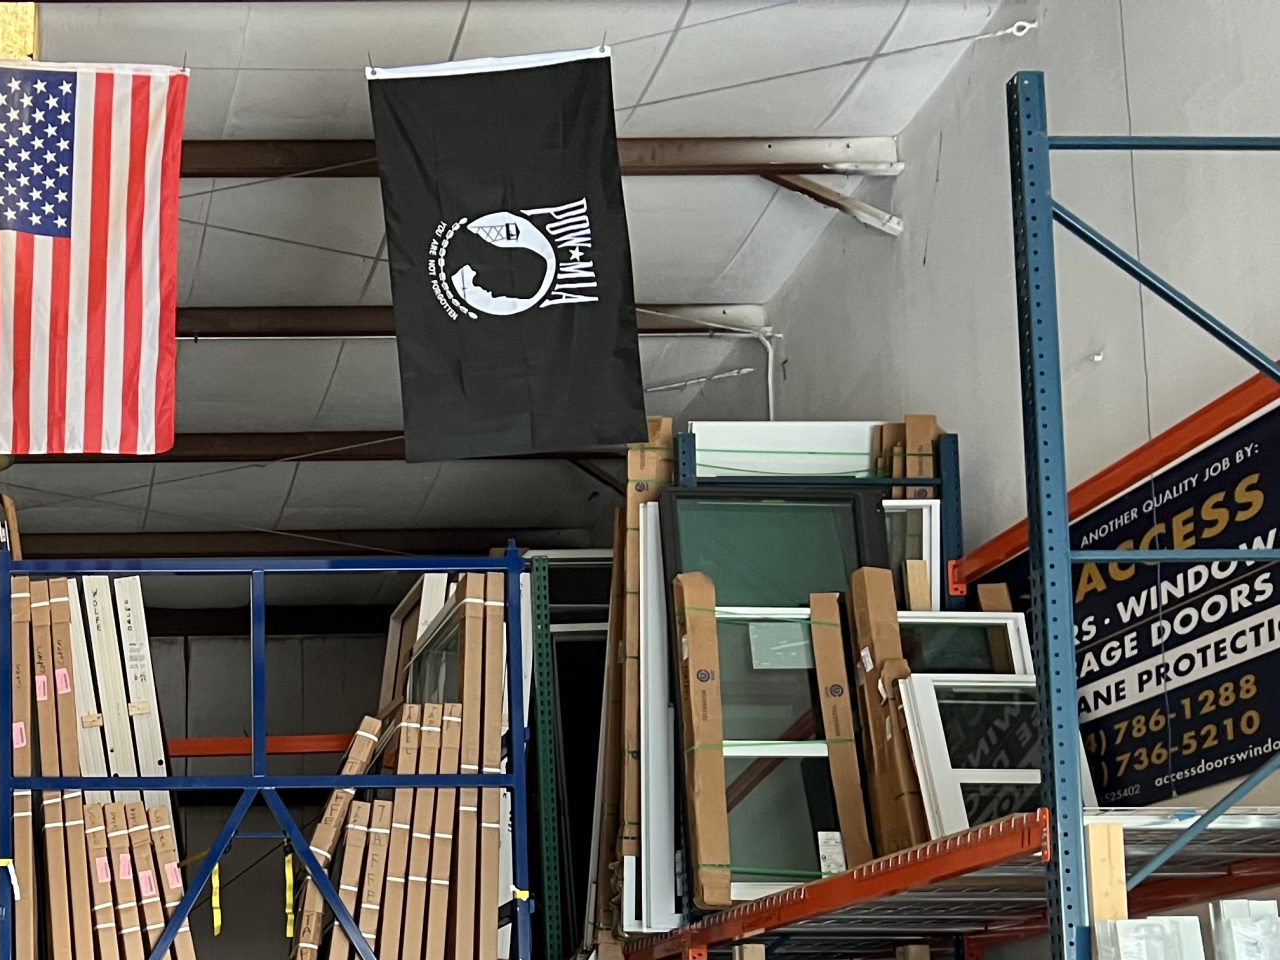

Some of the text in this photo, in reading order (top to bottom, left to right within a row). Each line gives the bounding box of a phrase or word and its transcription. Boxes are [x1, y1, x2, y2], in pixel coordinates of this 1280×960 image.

[427, 220, 458, 321] YOU ARE NOT FORGOTTEN
[520, 197, 599, 309] POW MIA
[1075, 473, 1265, 603] ACCESS
[1080, 443, 1260, 549] ANOTHER QUALITY JOB BY:
[1078, 572, 1274, 679] AGE DOORS
[1116, 527, 1280, 624] WINDOW
[1138, 618, 1280, 693] PROTECTI
[1113, 674, 1258, 745] 786-1288
[1116, 710, 1261, 777] 736-5210
